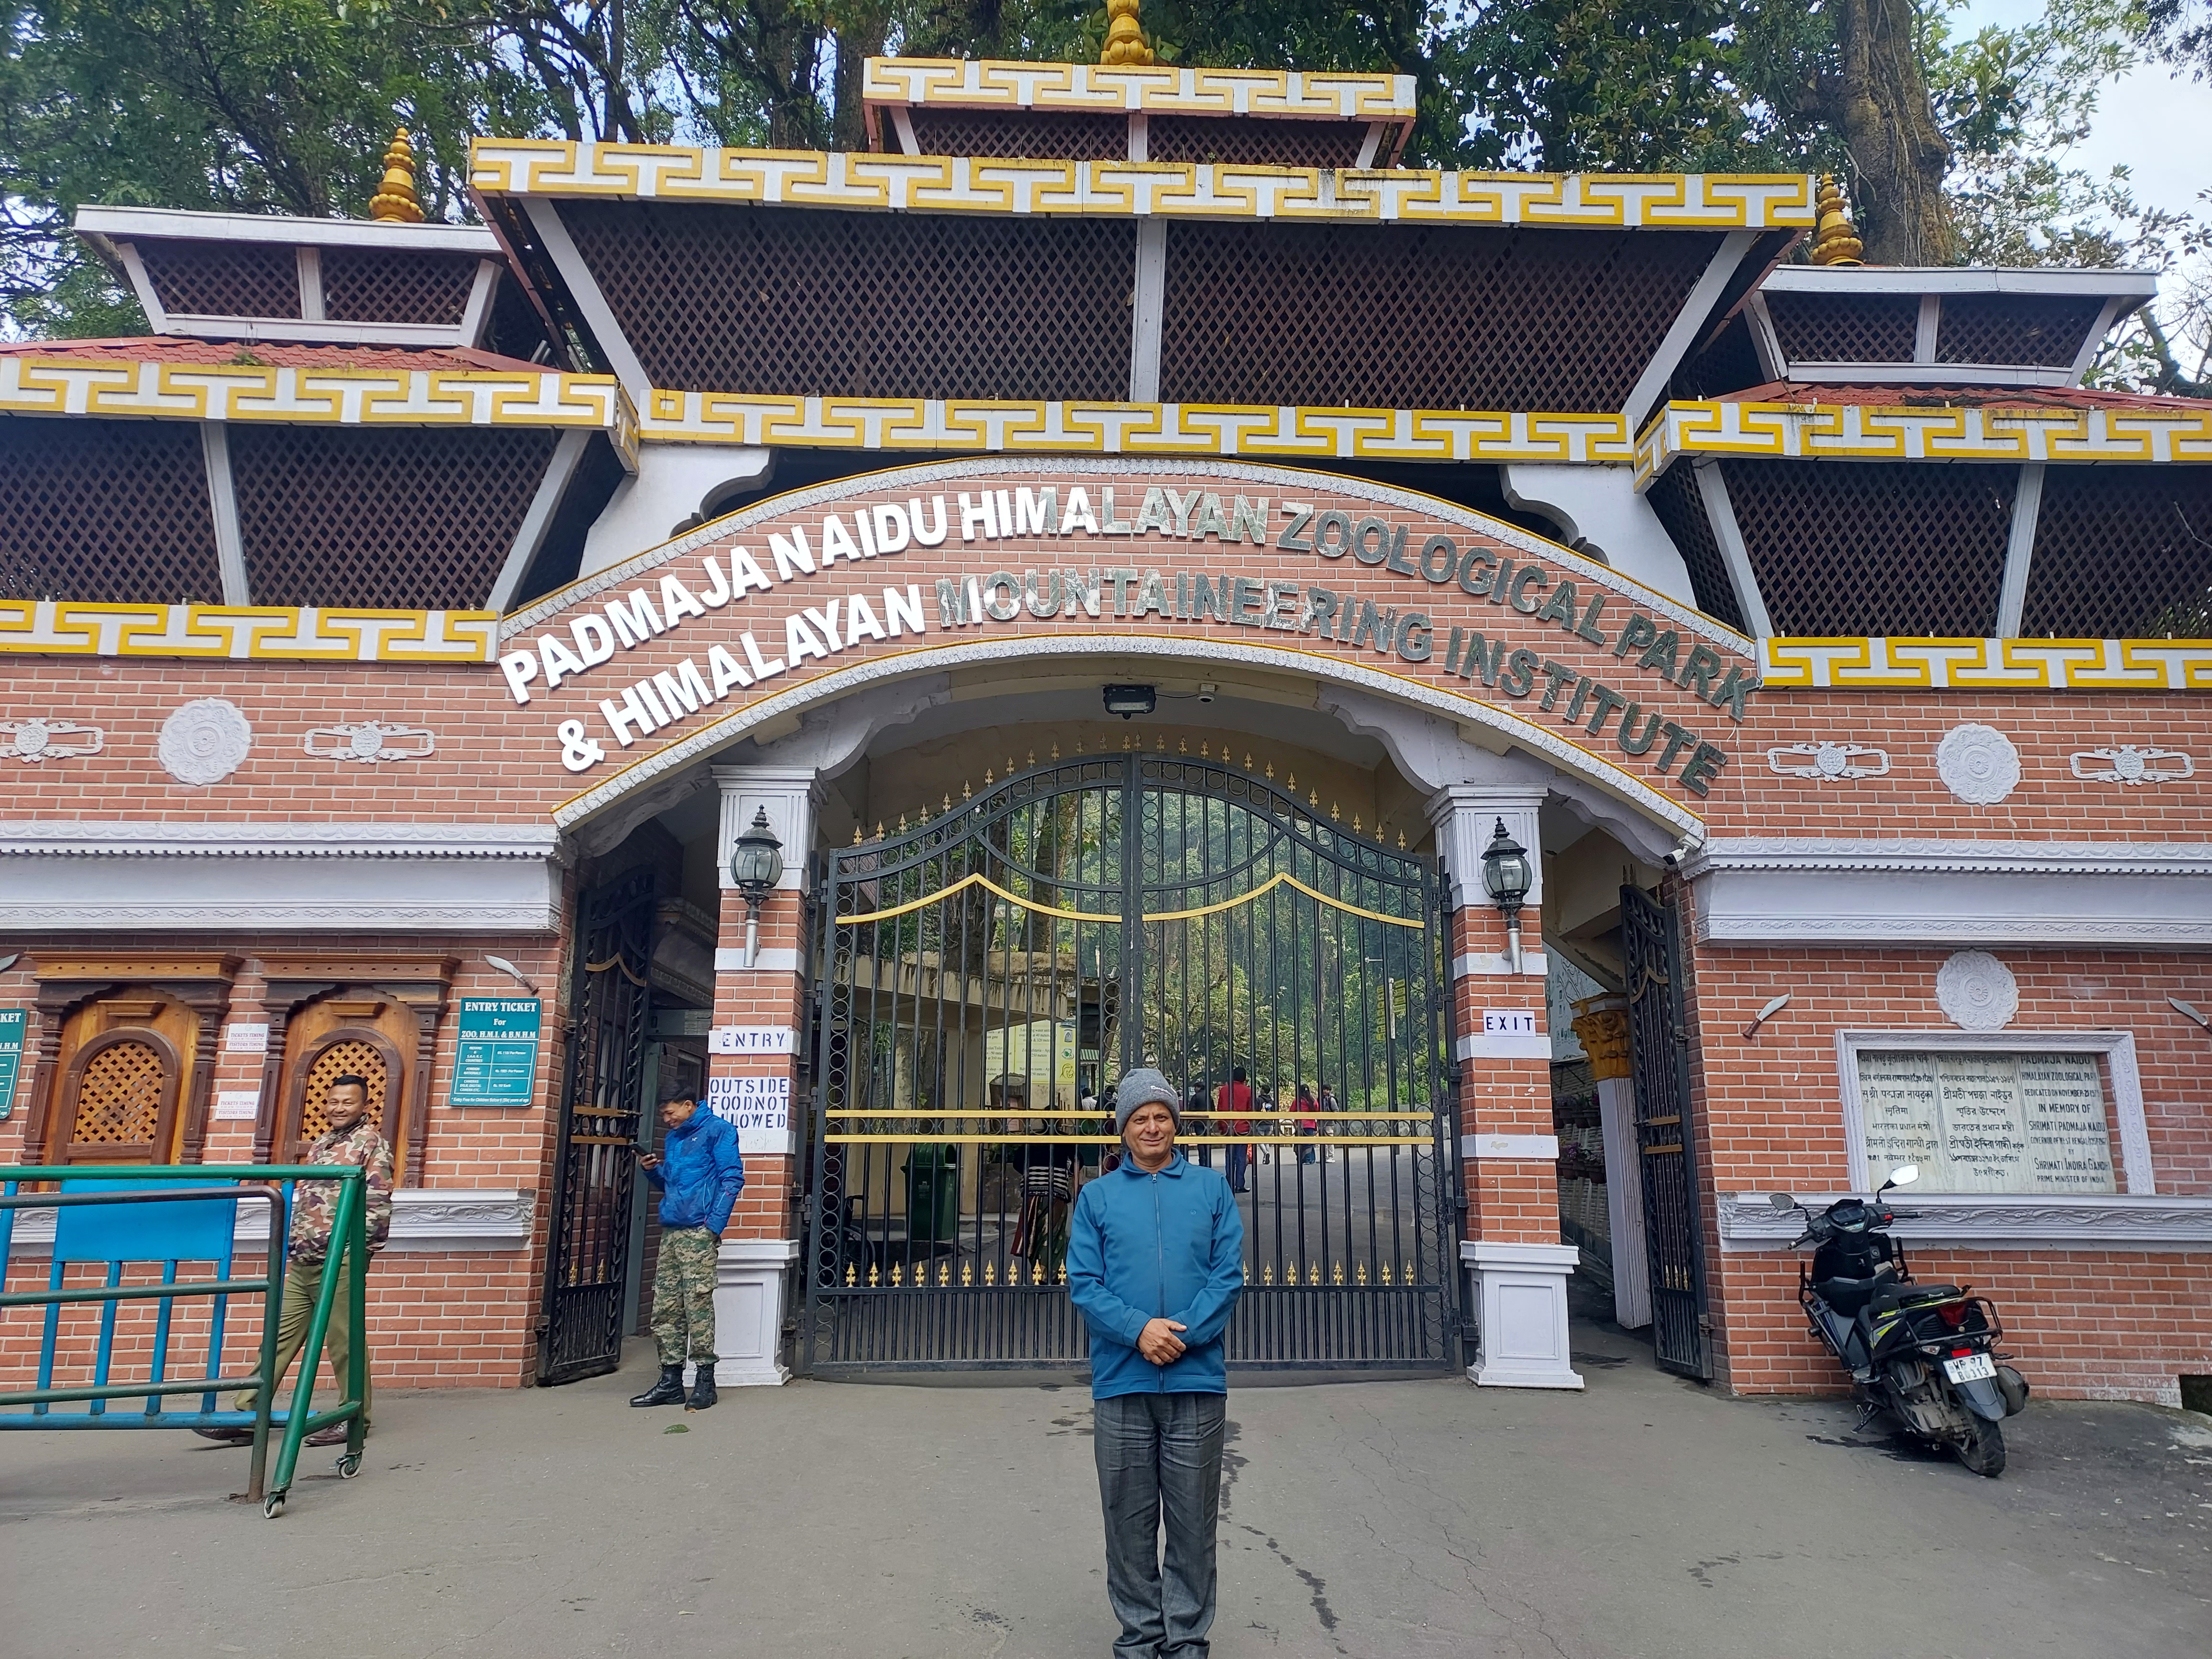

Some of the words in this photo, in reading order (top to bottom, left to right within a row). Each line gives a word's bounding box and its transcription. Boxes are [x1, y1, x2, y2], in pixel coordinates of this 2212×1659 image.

[499, 546, 773, 705] PADMAJA
[767, 495, 948, 581] NAIDU
[958, 486, 1269, 544] HIMALAYAN
[1277, 501, 1606, 646] ZOOLOGICAL
[1612, 612, 1762, 722] PARK
[557, 719, 605, 772] &
[598, 583, 926, 747] HIMALAYAN
[935, 568, 1433, 662] MOUNTAINEERING
[1444, 625, 1727, 797] INSTITUTE
[465, 1002, 498, 1012] ENTRY
[500, 1002, 536, 1012] TICKET
[1486, 1017, 1533, 1030] EXIT
[722, 1033, 785, 1047] ENTRY
[2021, 1055, 2061, 1064] PADMAJA
[2065, 1055, 2090, 1064] NAIDU
[2021, 1072, 2050, 1081] HIMALAYAN
[2051, 1072, 2083, 1081] ZOOLOGICAL
[710, 1078, 787, 1094] OUTSIDE
[2038, 1104, 2046, 1113] IN
[2049, 1104, 2079, 1113] MEMORY
[2082, 1104, 2091, 1113] OF
[2029, 1121, 2057, 1131] SHRIMATI
[2058, 1121, 2087, 1131] PADMAJA
[2031, 1137, 2052, 1145] GOVERNOR
